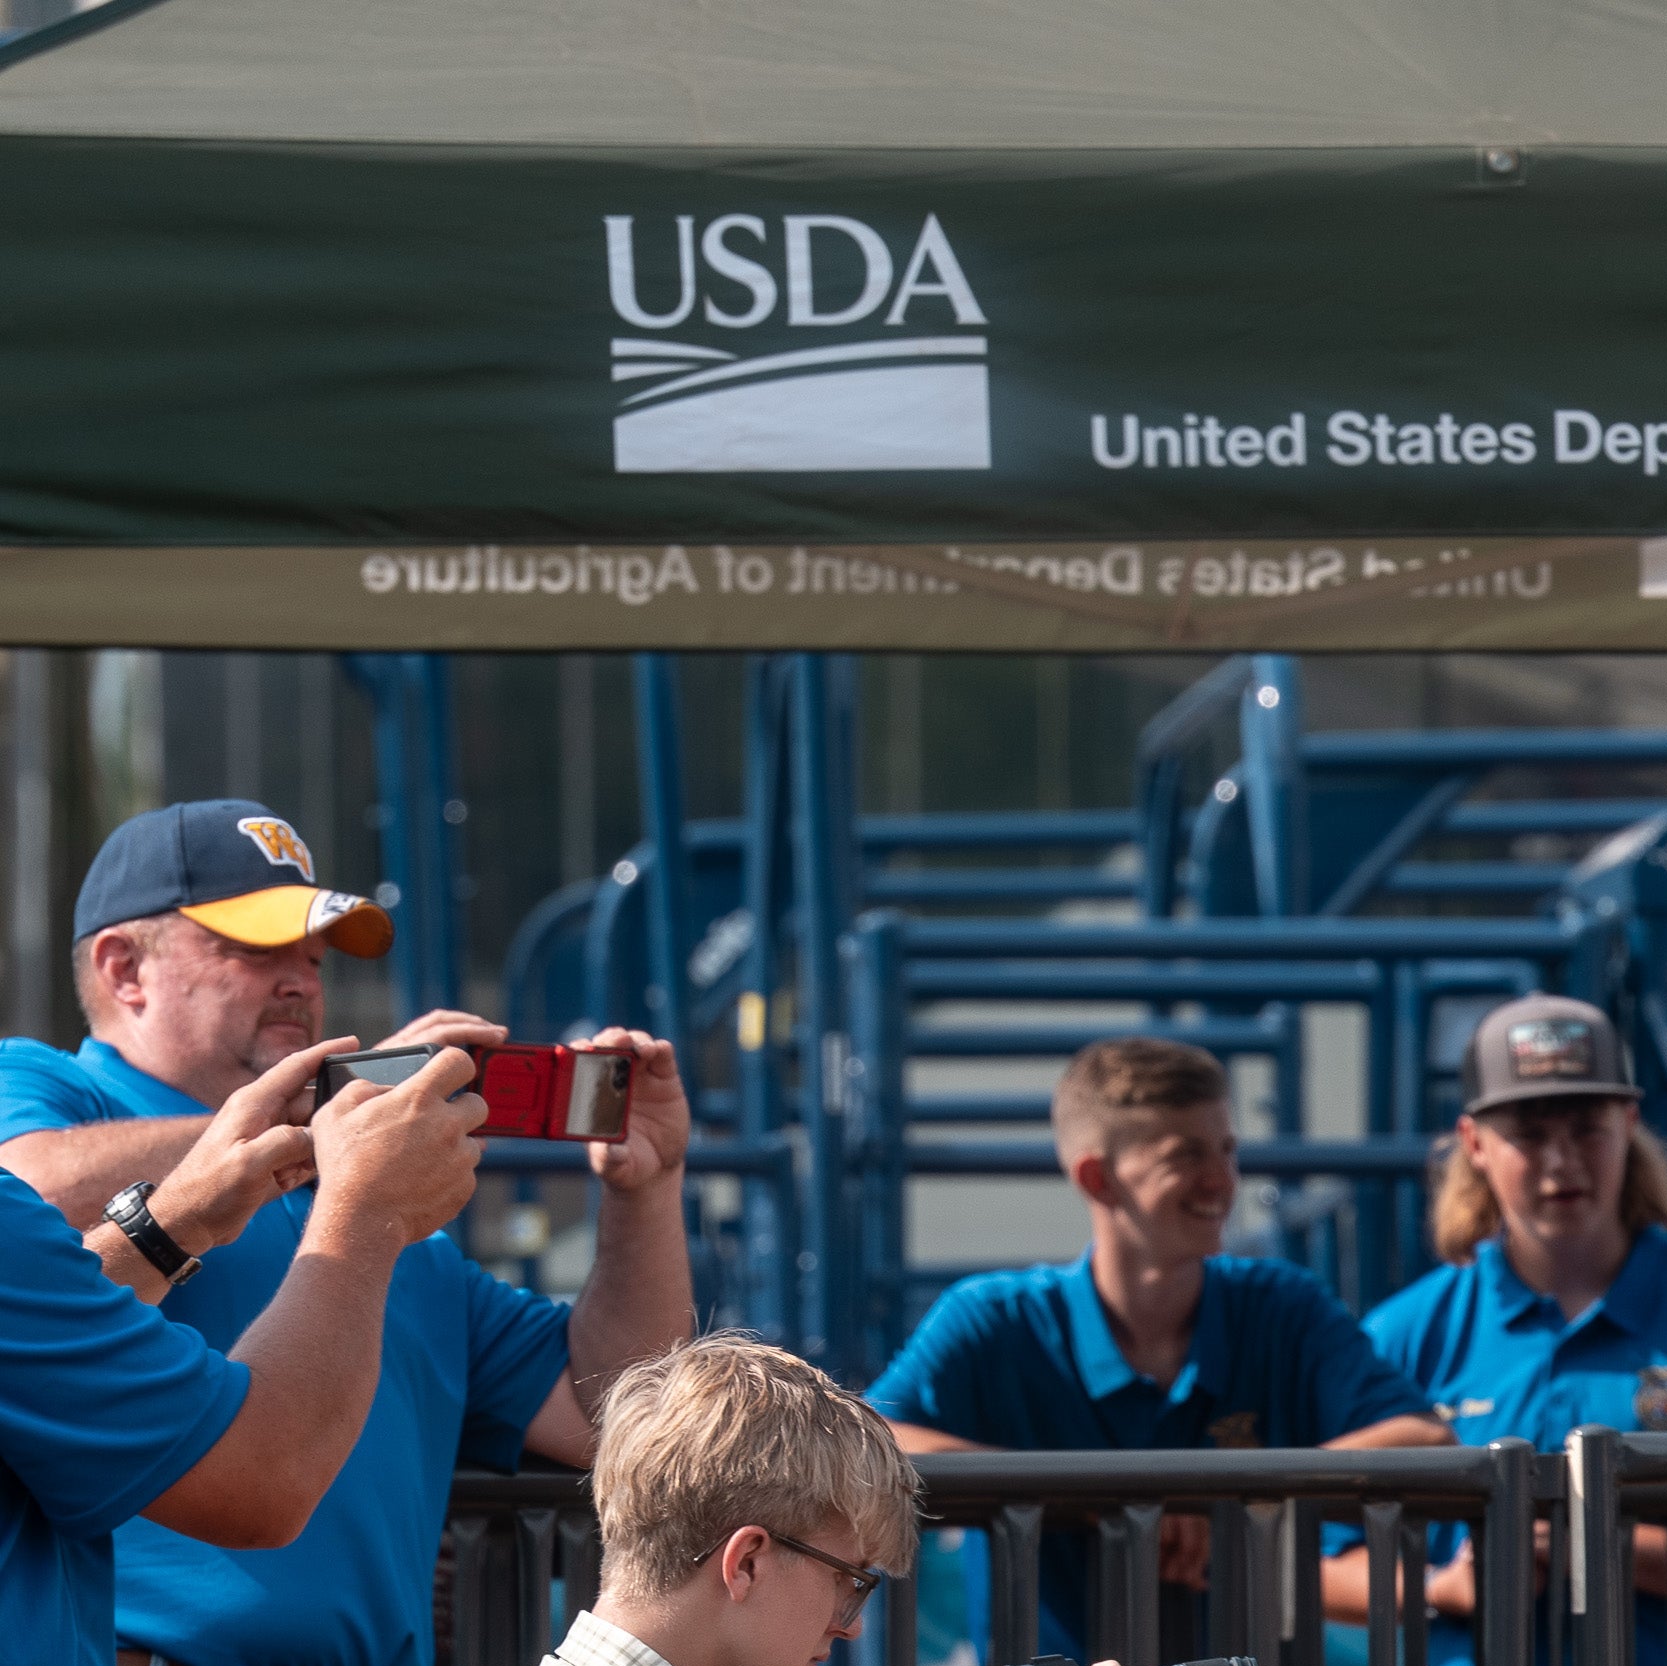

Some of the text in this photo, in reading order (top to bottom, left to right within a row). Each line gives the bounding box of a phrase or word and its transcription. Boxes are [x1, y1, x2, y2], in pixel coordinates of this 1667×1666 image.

[603, 212, 989, 329] USDA
[1091, 413, 1307, 469] United
[1326, 410, 1537, 467] States
